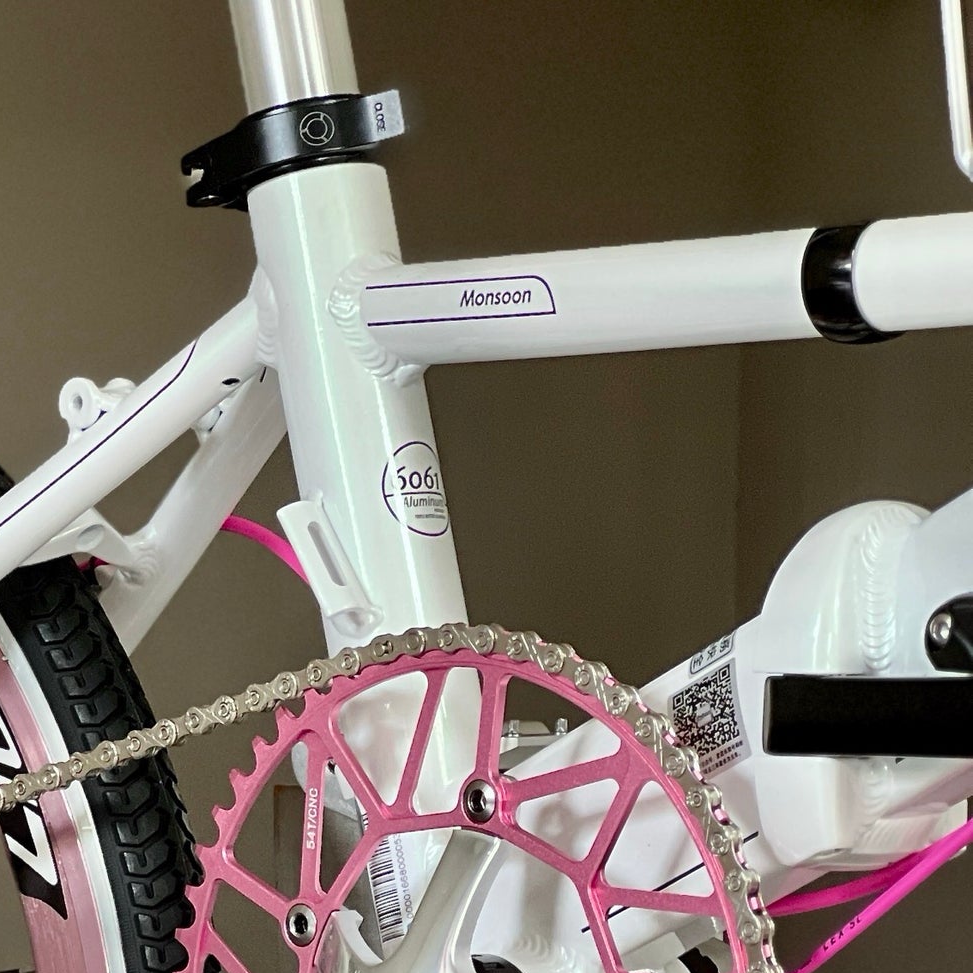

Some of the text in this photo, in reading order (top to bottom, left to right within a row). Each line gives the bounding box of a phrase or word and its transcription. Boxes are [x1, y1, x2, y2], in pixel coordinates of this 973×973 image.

[459, 289, 532, 308] Monsoon
[392, 466, 440, 490] 6061
[306, 787, 319, 850] 54T/CNC
